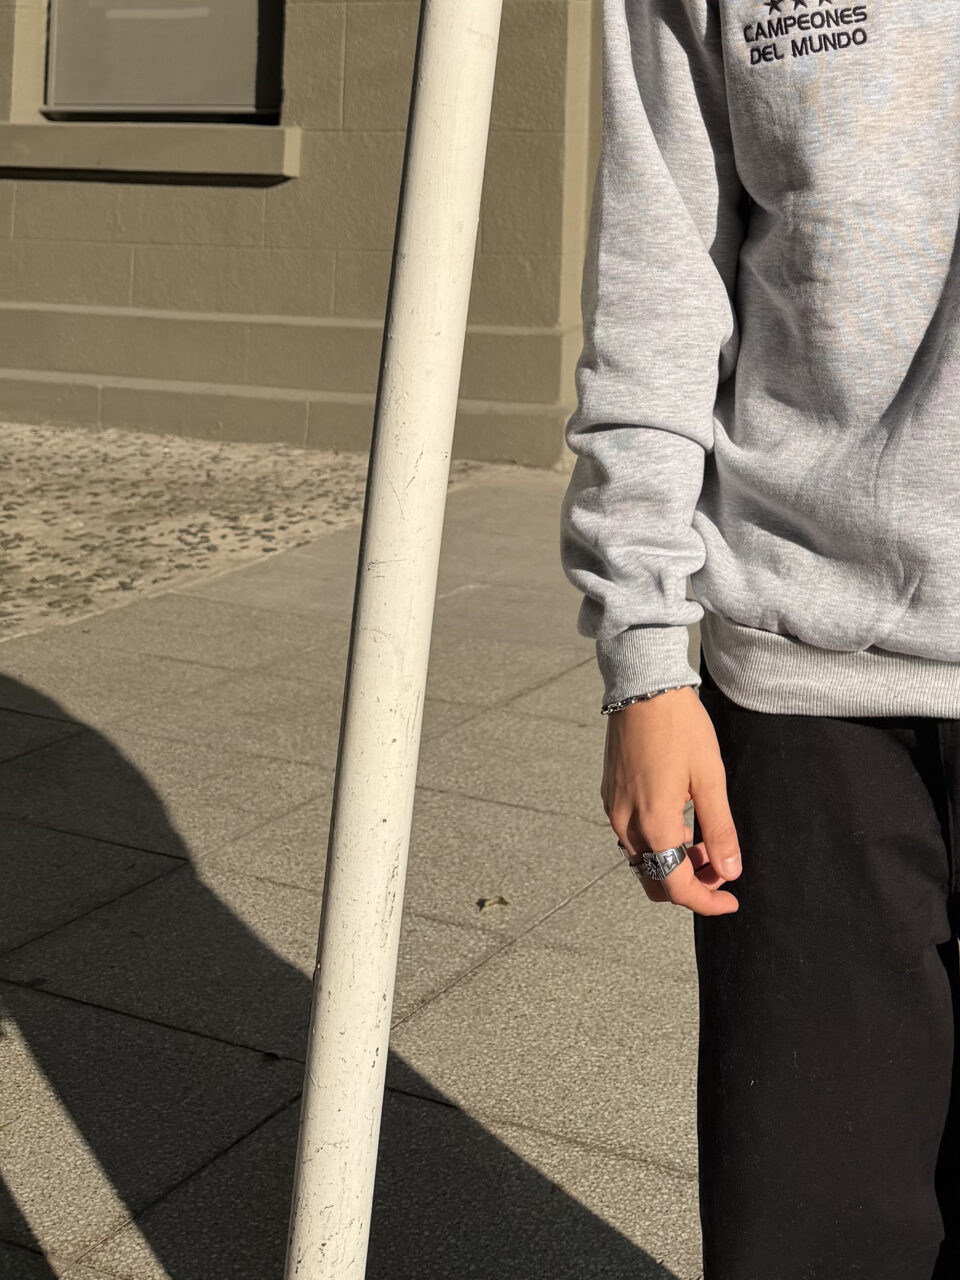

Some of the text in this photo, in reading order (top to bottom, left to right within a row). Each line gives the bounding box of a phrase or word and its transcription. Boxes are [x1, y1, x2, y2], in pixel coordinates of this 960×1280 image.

[743, 5, 868, 43] CAMPEONES
[750, 27, 868, 65] DEL MUNDO
